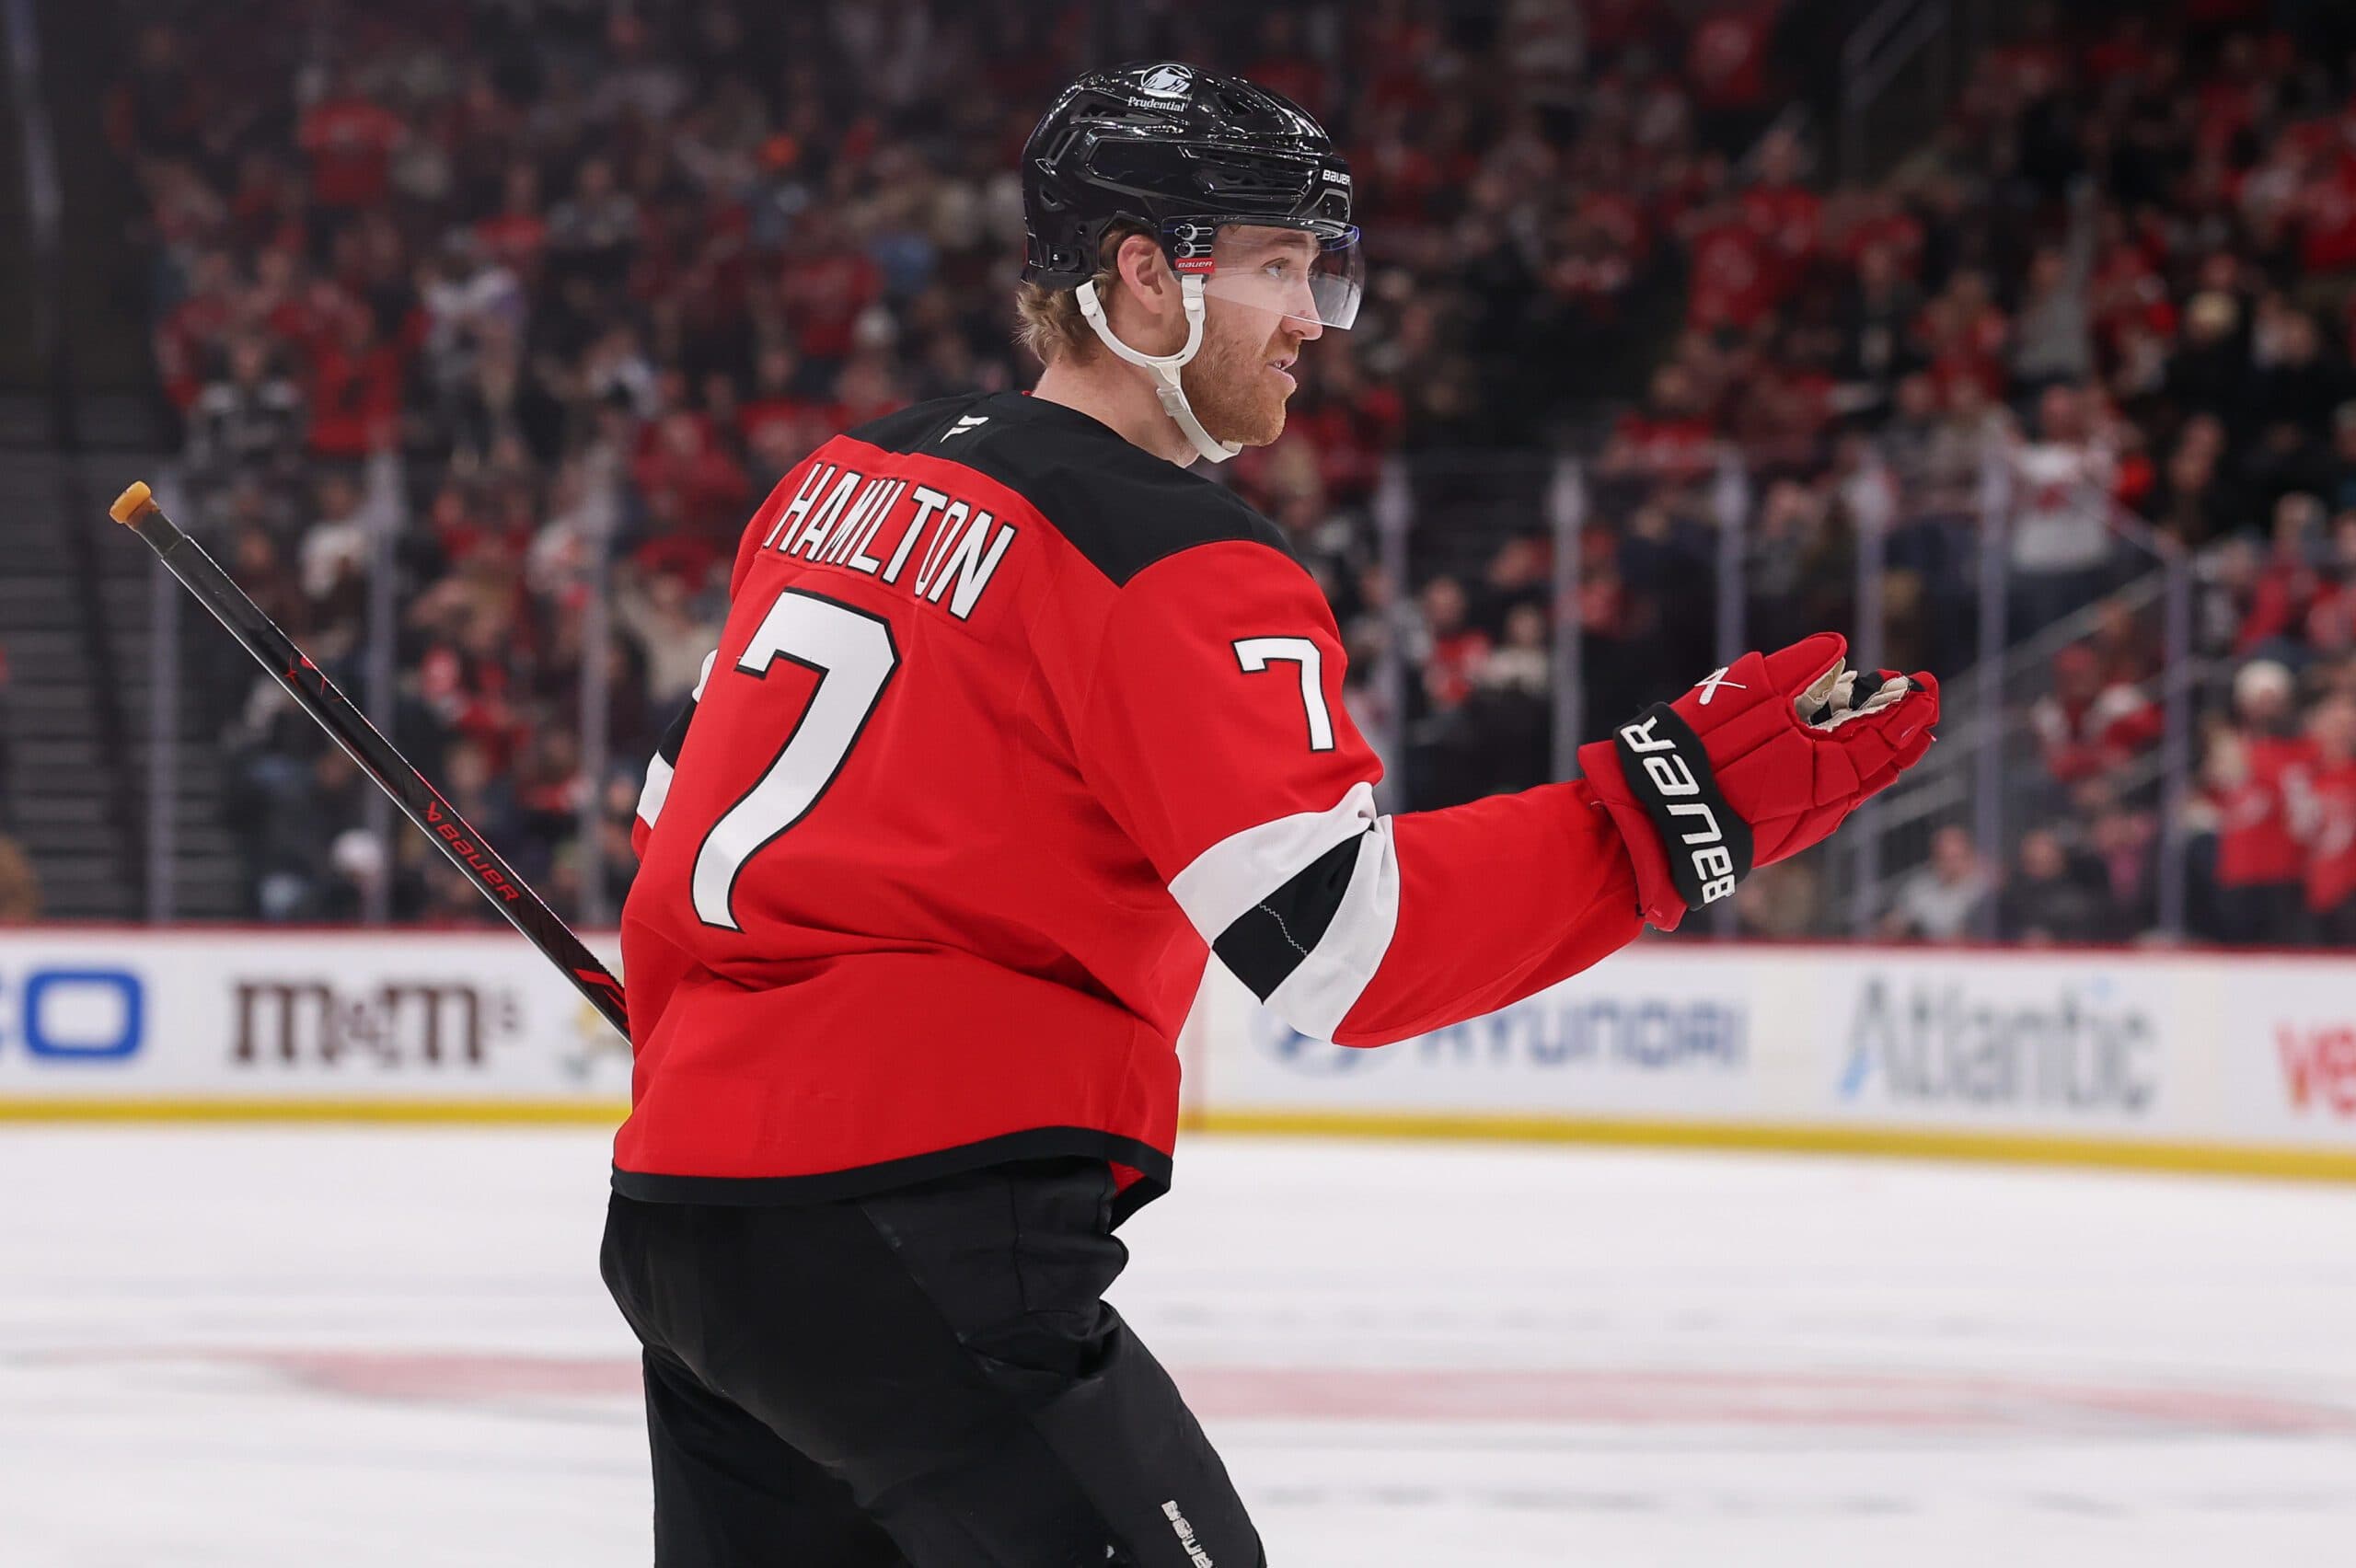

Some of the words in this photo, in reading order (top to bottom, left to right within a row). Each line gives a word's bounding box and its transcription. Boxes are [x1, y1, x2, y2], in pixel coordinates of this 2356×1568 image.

[1127, 96, 1185, 112] Prudential
[763, 463, 1017, 623] HAMILTON
[690, 587, 902, 934] 7
[1232, 636, 1334, 753] 7
